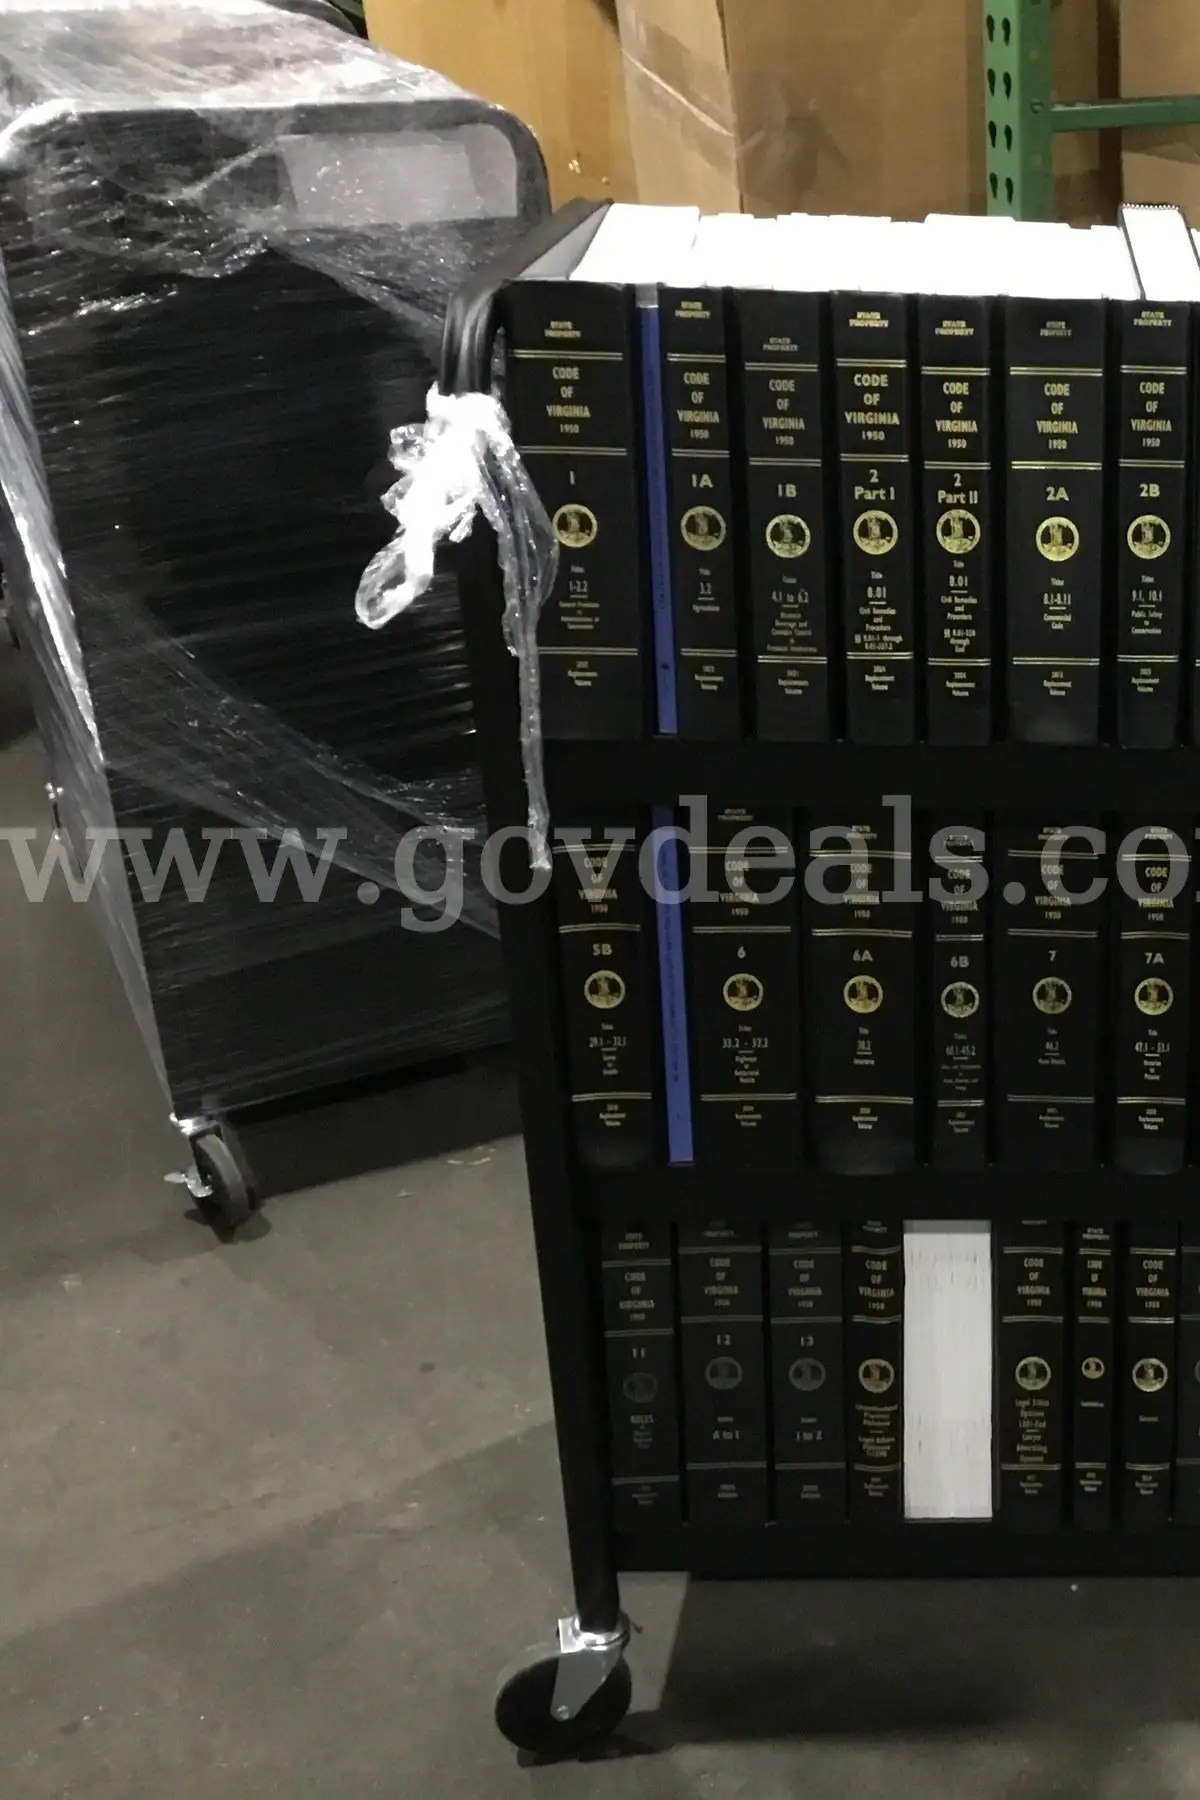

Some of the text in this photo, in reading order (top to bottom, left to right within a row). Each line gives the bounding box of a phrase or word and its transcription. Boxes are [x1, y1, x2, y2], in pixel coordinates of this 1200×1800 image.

[553, 367, 579, 379] CODE
[684, 372, 709, 384] CODE
[769, 380, 795, 391] CODE
[854, 374, 888, 386] CODE
[561, 386, 573, 398] OF
[943, 382, 968, 395] CODE
[1044, 383, 1069, 396] CODE
[1140, 382, 1164, 394] CODE
[691, 391, 703, 403] OF
[864, 393, 880, 405] OF
[777, 399, 789, 410] OF
[950, 401, 962, 413] OF
[1051, 402, 1063, 414] OF
[1146, 401, 1158, 412] OF
[546, 405, 590, 417] VIRGINIA
[677, 410, 719, 422] VIRGINIA
[763, 417, 805, 429] VIRGINIA
[845, 412, 899, 424] VIRGINIA
[936, 420, 977, 432] VIRGINIA
[1037, 421, 1078, 433] VIRGINIA
[1131, 419, 1171, 431] VIRGINIA
[691, 429, 709, 439] 1950
[1049, 439, 1067, 449] 1950
[870, 469, 878, 482] 2
[954, 473, 961, 486] 2
[855, 486, 885, 500] Part
[938, 490, 965, 503] Part
[1047, 487, 1069, 500] 2A
[1140, 484, 1160, 497] 2B
[738, 947, 745, 958] 6
[853, 950, 872, 961] 6A
[1049, 951, 1056, 961] 7
[1145, 953, 1164, 963] 7A
[951, 956, 969, 967] 6B
[1024, 1258, 1043, 1267] CODE
[1029, 1272, 1038, 1280] OF
[1017, 1286, 1050, 1294] VIRGINIA
